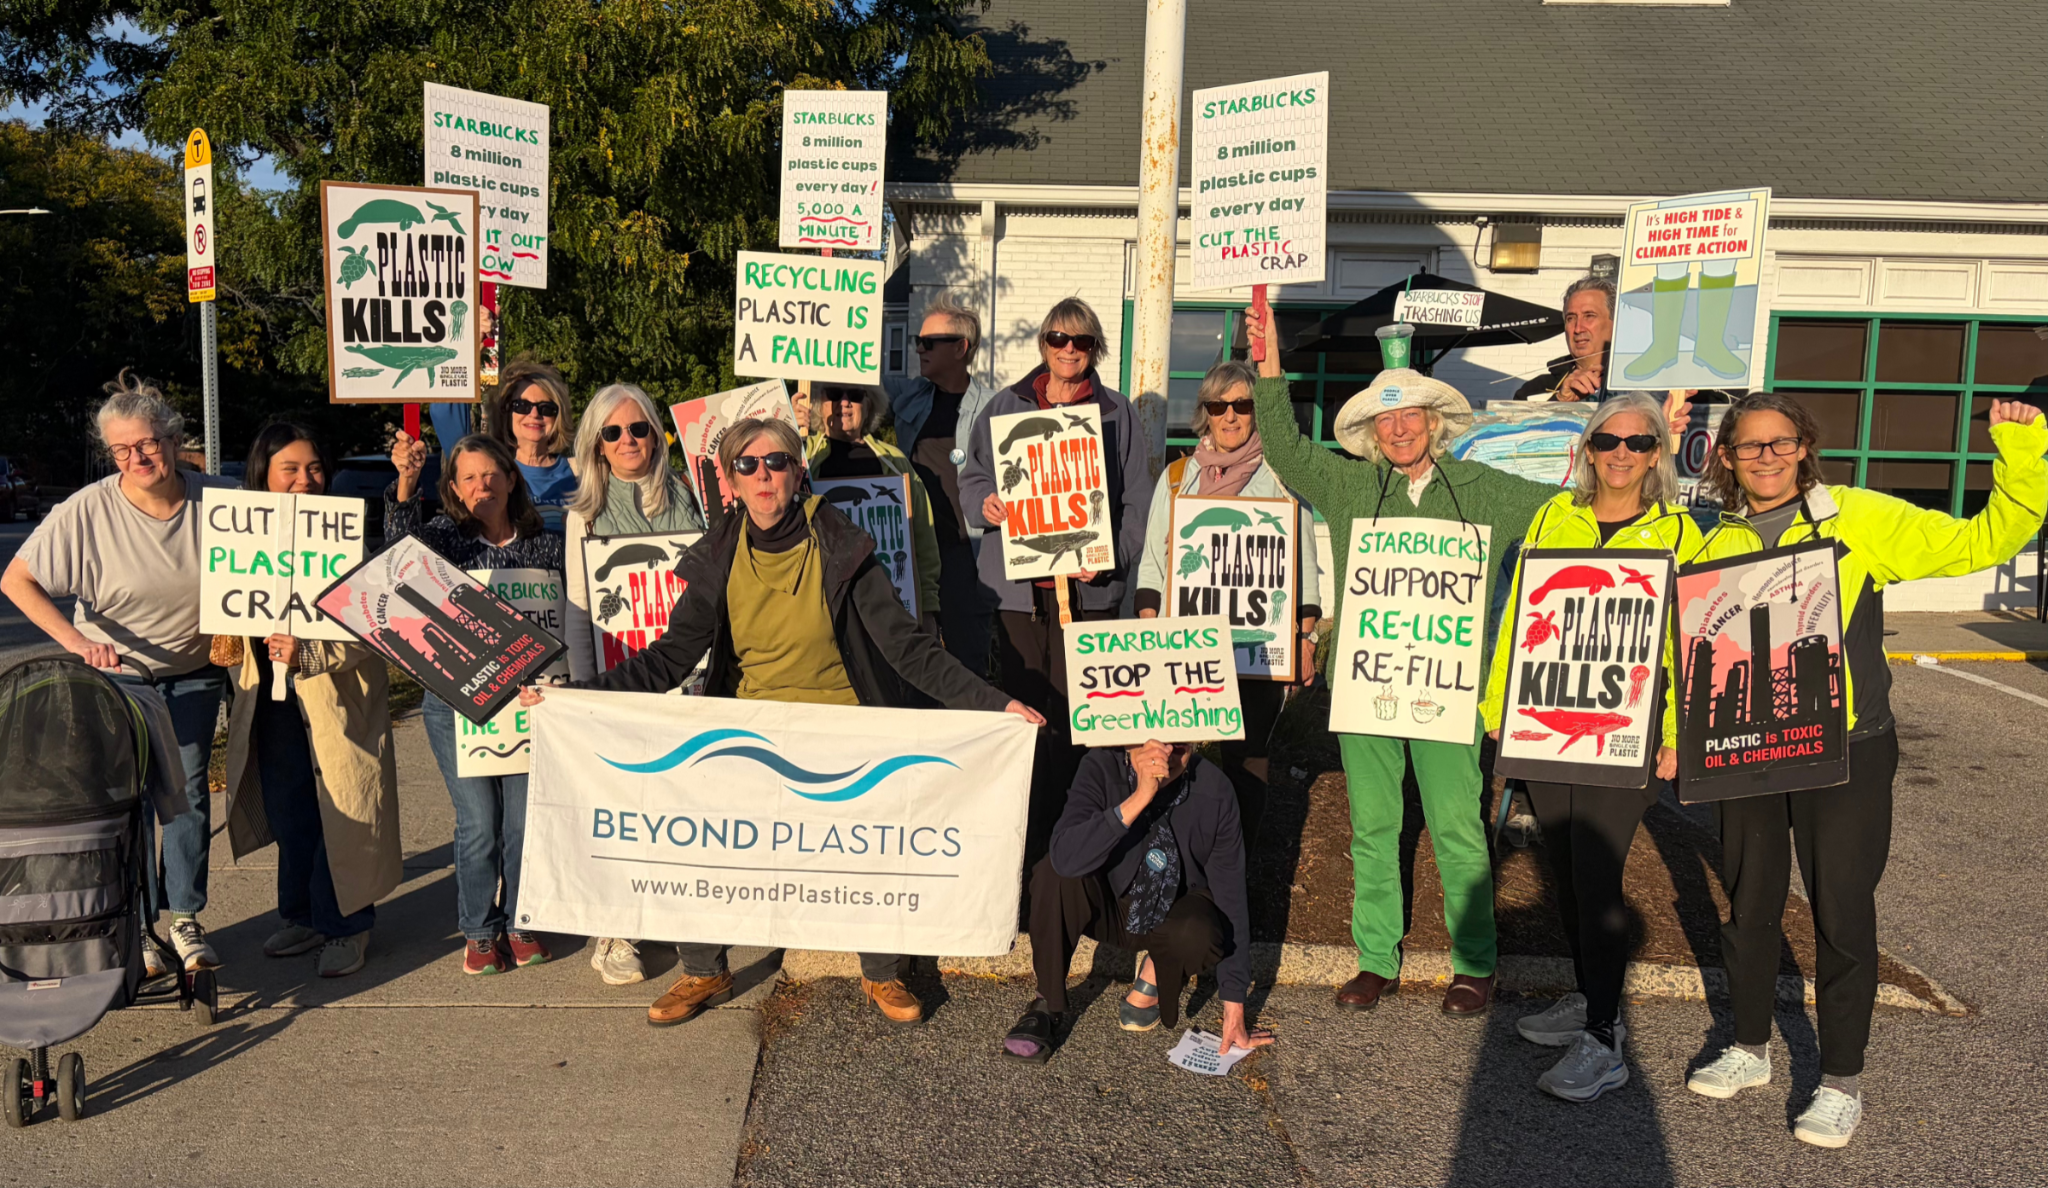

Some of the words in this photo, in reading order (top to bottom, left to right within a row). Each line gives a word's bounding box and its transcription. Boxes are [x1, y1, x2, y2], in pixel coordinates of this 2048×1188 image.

[1203, 88, 1316, 119] STARBUCKS
[433, 111, 539, 145] STARBUCKS
[793, 112, 875, 126] STARBUCKS
[802, 136, 811, 148] 8
[814, 135, 863, 149] million
[1217, 146, 1228, 160] 8
[1232, 138, 1296, 158] million
[450, 145, 462, 158] 8
[465, 146, 522, 169] million
[788, 158, 839, 171] plastic
[841, 160, 878, 173] cups
[434, 170, 497, 190] plastic
[499, 181, 540, 199] cups
[795, 181, 838, 194] every
[1200, 170, 1265, 193] plastic
[1269, 167, 1317, 183] cups
[500, 206, 530, 224] day
[797, 202, 844, 216] 5,000
[852, 203, 862, 216] A
[1210, 201, 1265, 218] every
[1269, 197, 1305, 212] day
[1646, 214, 1660, 227] It's
[1664, 210, 1698, 225] HIGH
[1702, 208, 1732, 221] TIDE
[1735, 207, 1743, 219] &
[486, 228, 502, 244] IT
[511, 233, 546, 250] OUT
[1200, 230, 1235, 248] CUT
[1243, 226, 1280, 244] THE
[1648, 228, 1681, 242] HIGH
[1686, 225, 1719, 239] TIME
[1723, 223, 1738, 237] for
[482, 255, 515, 272] OW
[1222, 240, 1294, 260] PLASTIC
[1260, 253, 1308, 270] CRAP
[1636, 243, 1692, 259] CLIMATE
[1696, 239, 1748, 255] ACTION
[377, 231, 465, 299] PLASTIC
[745, 261, 876, 295] RECYCLING
[738, 297, 831, 327] PLASTIC
[847, 305, 868, 329] IS
[1405, 291, 1460, 306] STARBUCKS
[1462, 293, 1484, 306] STOP
[341, 298, 446, 343] KILLS
[1404, 305, 1463, 323] TRASHING
[1465, 309, 1481, 324] US
[738, 333, 757, 363] A
[771, 334, 878, 373] FAILURE
[441, 379, 467, 387] PLASTIC
[700, 415, 716, 453] Diabetes
[1027, 437, 1100, 497] PLASTIC
[209, 505, 275, 535] CUT
[299, 510, 361, 543] THE
[1005, 493, 1088, 538] KILLS
[1210, 533, 1286, 589] PLASTIC
[1358, 531, 1488, 562] STARBUCKS
[209, 546, 347, 579] PLASTIC
[398, 560, 415, 579] ASTHMA
[1350, 567, 1482, 605] SUPPORT
[1752, 576, 1774, 601] Hormone
[1799, 581, 1822, 610] disorders
[360, 591, 377, 628] Diabetes
[376, 593, 389, 625] CANCER
[1179, 586, 1268, 627] KILLS
[1699, 591, 1728, 634] Diabetes
[1708, 604, 1743, 636] CANCER
[1805, 590, 1835, 633] INFERTILITY
[1359, 608, 1474, 647] RE-USE
[1559, 597, 1655, 664] PLASTIC
[1796, 610, 1805, 636] Thyroid
[1075, 628, 1219, 654] STARBUCKS
[460, 661, 501, 697] PLASTIC
[496, 654, 510, 665] is
[505, 634, 534, 656] TOXIC
[473, 690, 493, 707] OIL
[488, 682, 501, 692] &
[496, 642, 546, 685] CHEMICALS
[1079, 663, 1151, 689] STOP
[1164, 659, 1225, 686] THE
[1260, 658, 1284, 666] PLASTIC
[1352, 650, 1474, 691] RE-FILL
[1518, 661, 1626, 710] KILLS
[1072, 697, 1241, 736] GreenWashing
[1611, 734, 1621, 743] NO
[1621, 735, 1640, 744] MORE
[1706, 733, 1761, 752] PLASTIC
[1766, 731, 1777, 744] is
[1782, 724, 1823, 741] TOXIC
[1609, 748, 1638, 758] PLASTIC
[1705, 755, 1726, 768] OIL
[1729, 752, 1740, 765] &
[1743, 740, 1824, 763] CHEMICALS
[592, 808, 759, 850] BEYOND
[772, 821, 962, 857] PLASTICS
[631, 878, 920, 912] www.BeyondPlastics.org
